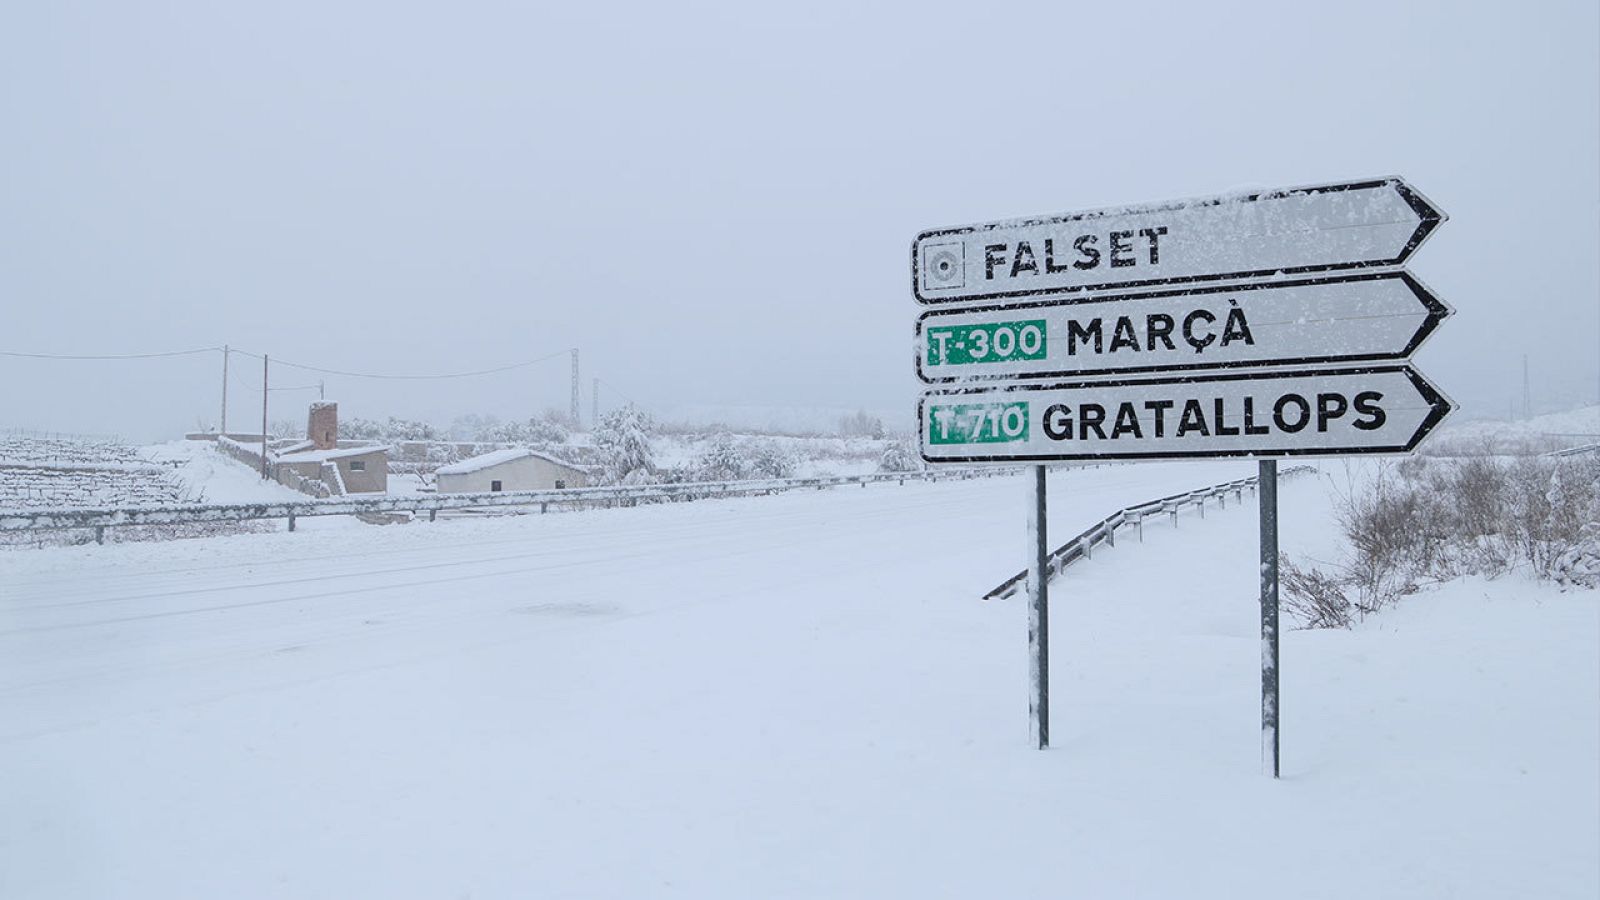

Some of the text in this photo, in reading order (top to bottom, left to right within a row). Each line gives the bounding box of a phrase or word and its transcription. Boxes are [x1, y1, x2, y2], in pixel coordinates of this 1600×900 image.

[985, 227, 1167, 279] FALSET
[933, 299, 1255, 360] T-300 MARÇÀ
[934, 391, 1387, 442] T-710 GRATALLOPS
